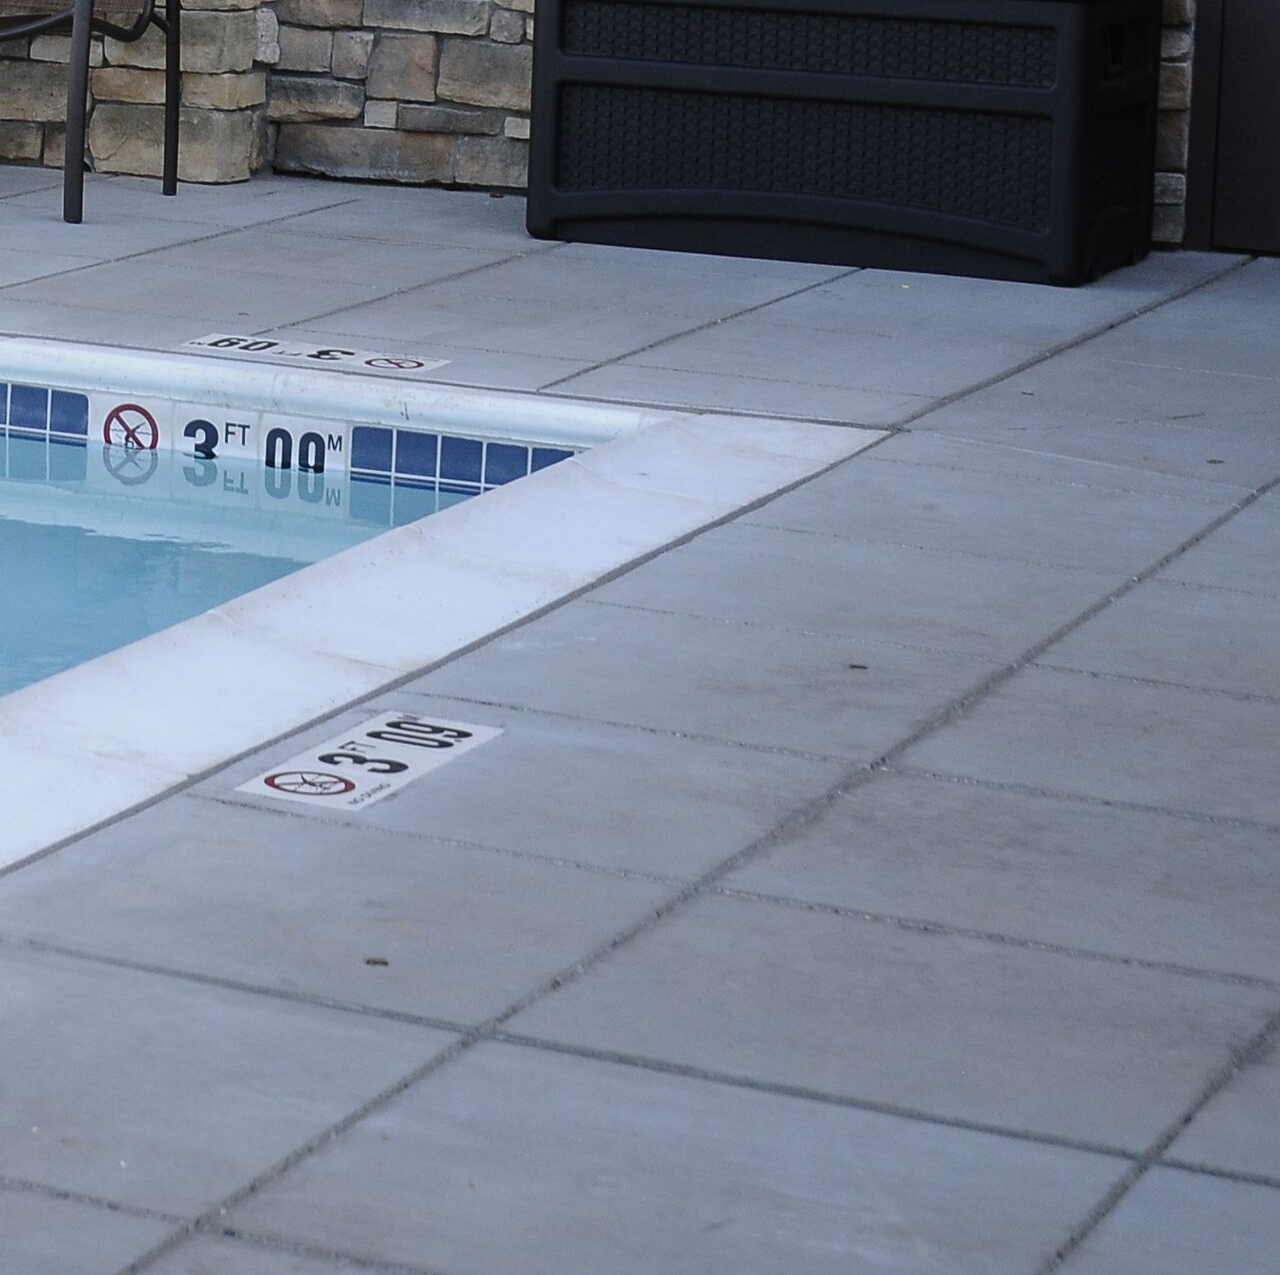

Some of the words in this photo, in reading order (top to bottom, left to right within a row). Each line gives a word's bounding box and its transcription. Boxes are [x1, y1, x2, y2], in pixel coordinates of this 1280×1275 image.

[183, 419, 219, 460] 3
[224, 422, 251, 446] FT
[327, 434, 343, 452] M
[318, 752, 409, 774] 3
